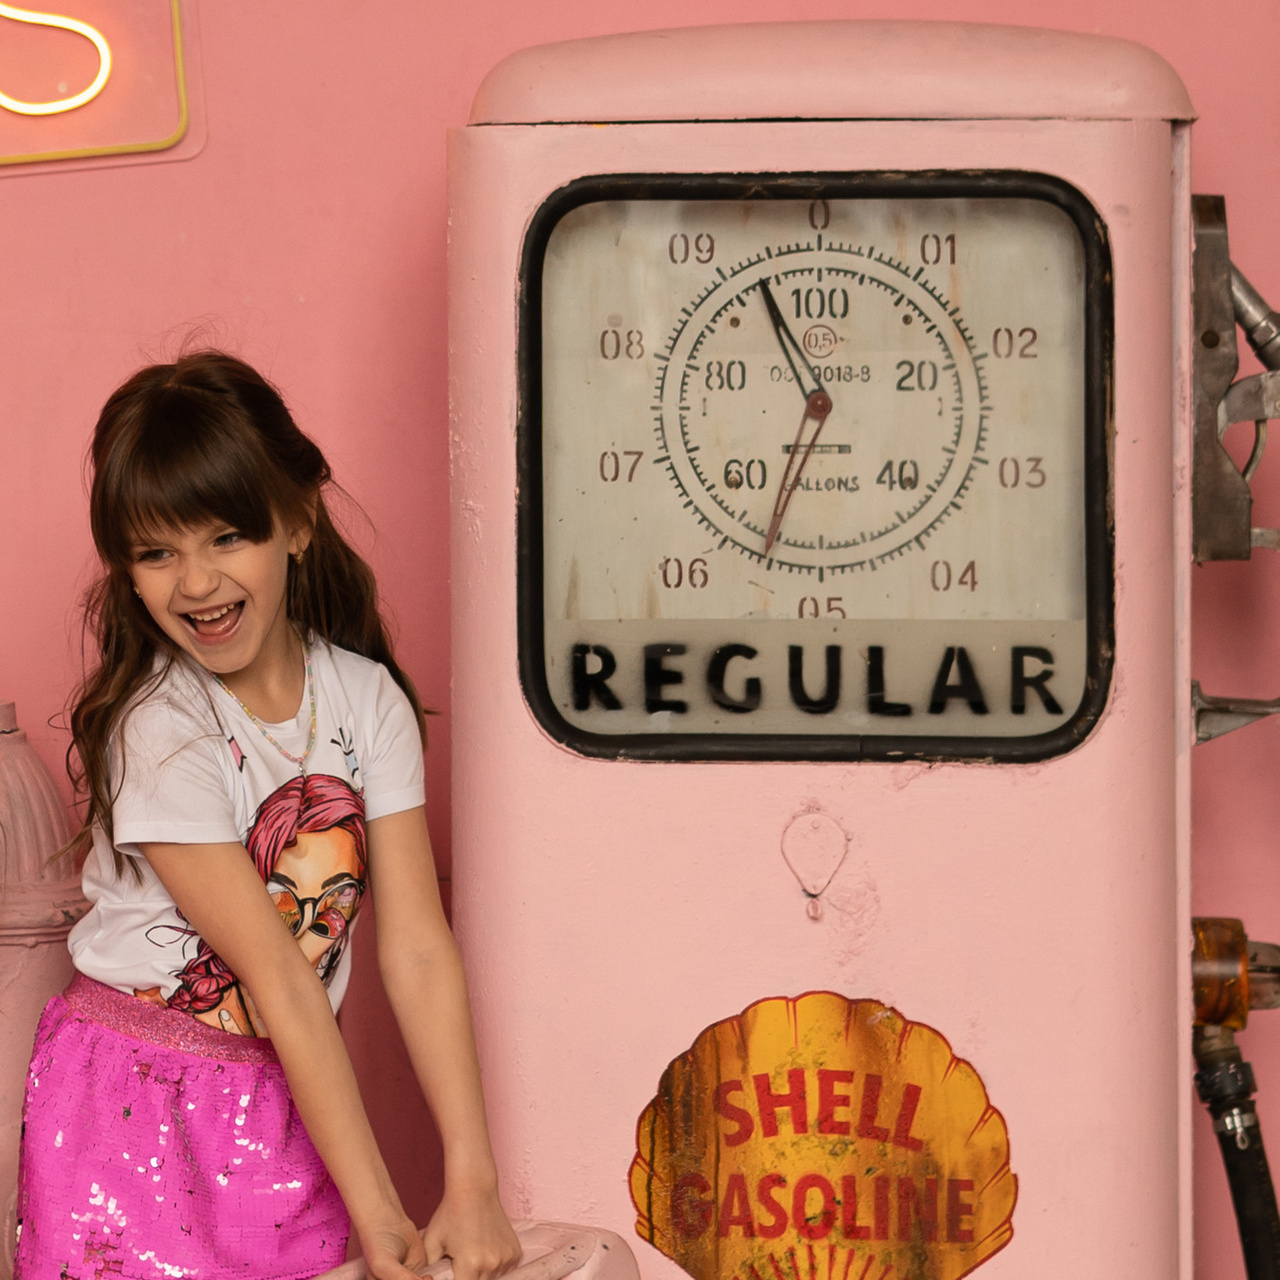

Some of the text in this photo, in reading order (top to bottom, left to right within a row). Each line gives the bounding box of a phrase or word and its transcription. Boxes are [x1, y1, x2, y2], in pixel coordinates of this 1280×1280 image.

[809, 199, 829, 230] 0
[668, 233, 715, 264] 09
[920, 233, 957, 265] 01
[791, 287, 849, 319] 100
[600, 329, 645, 360] 08
[807, 332, 832, 351] 0,5
[992, 327, 1038, 359] 02
[705, 360, 746, 391] 80
[896, 360, 938, 391] 20
[599, 451, 645, 482] 07
[723, 459, 767, 491] 60
[876, 459, 919, 491] 40
[999, 457, 1046, 489] 03
[784, 476, 860, 492] ALLONS
[661, 558, 709, 589] 06
[931, 560, 978, 592] 04
[798, 597, 846, 619] 05
[570, 642, 1064, 716] REGULAR
[712, 1068, 924, 1152] SHELL
[670, 1172, 975, 1243] GASOLINE
